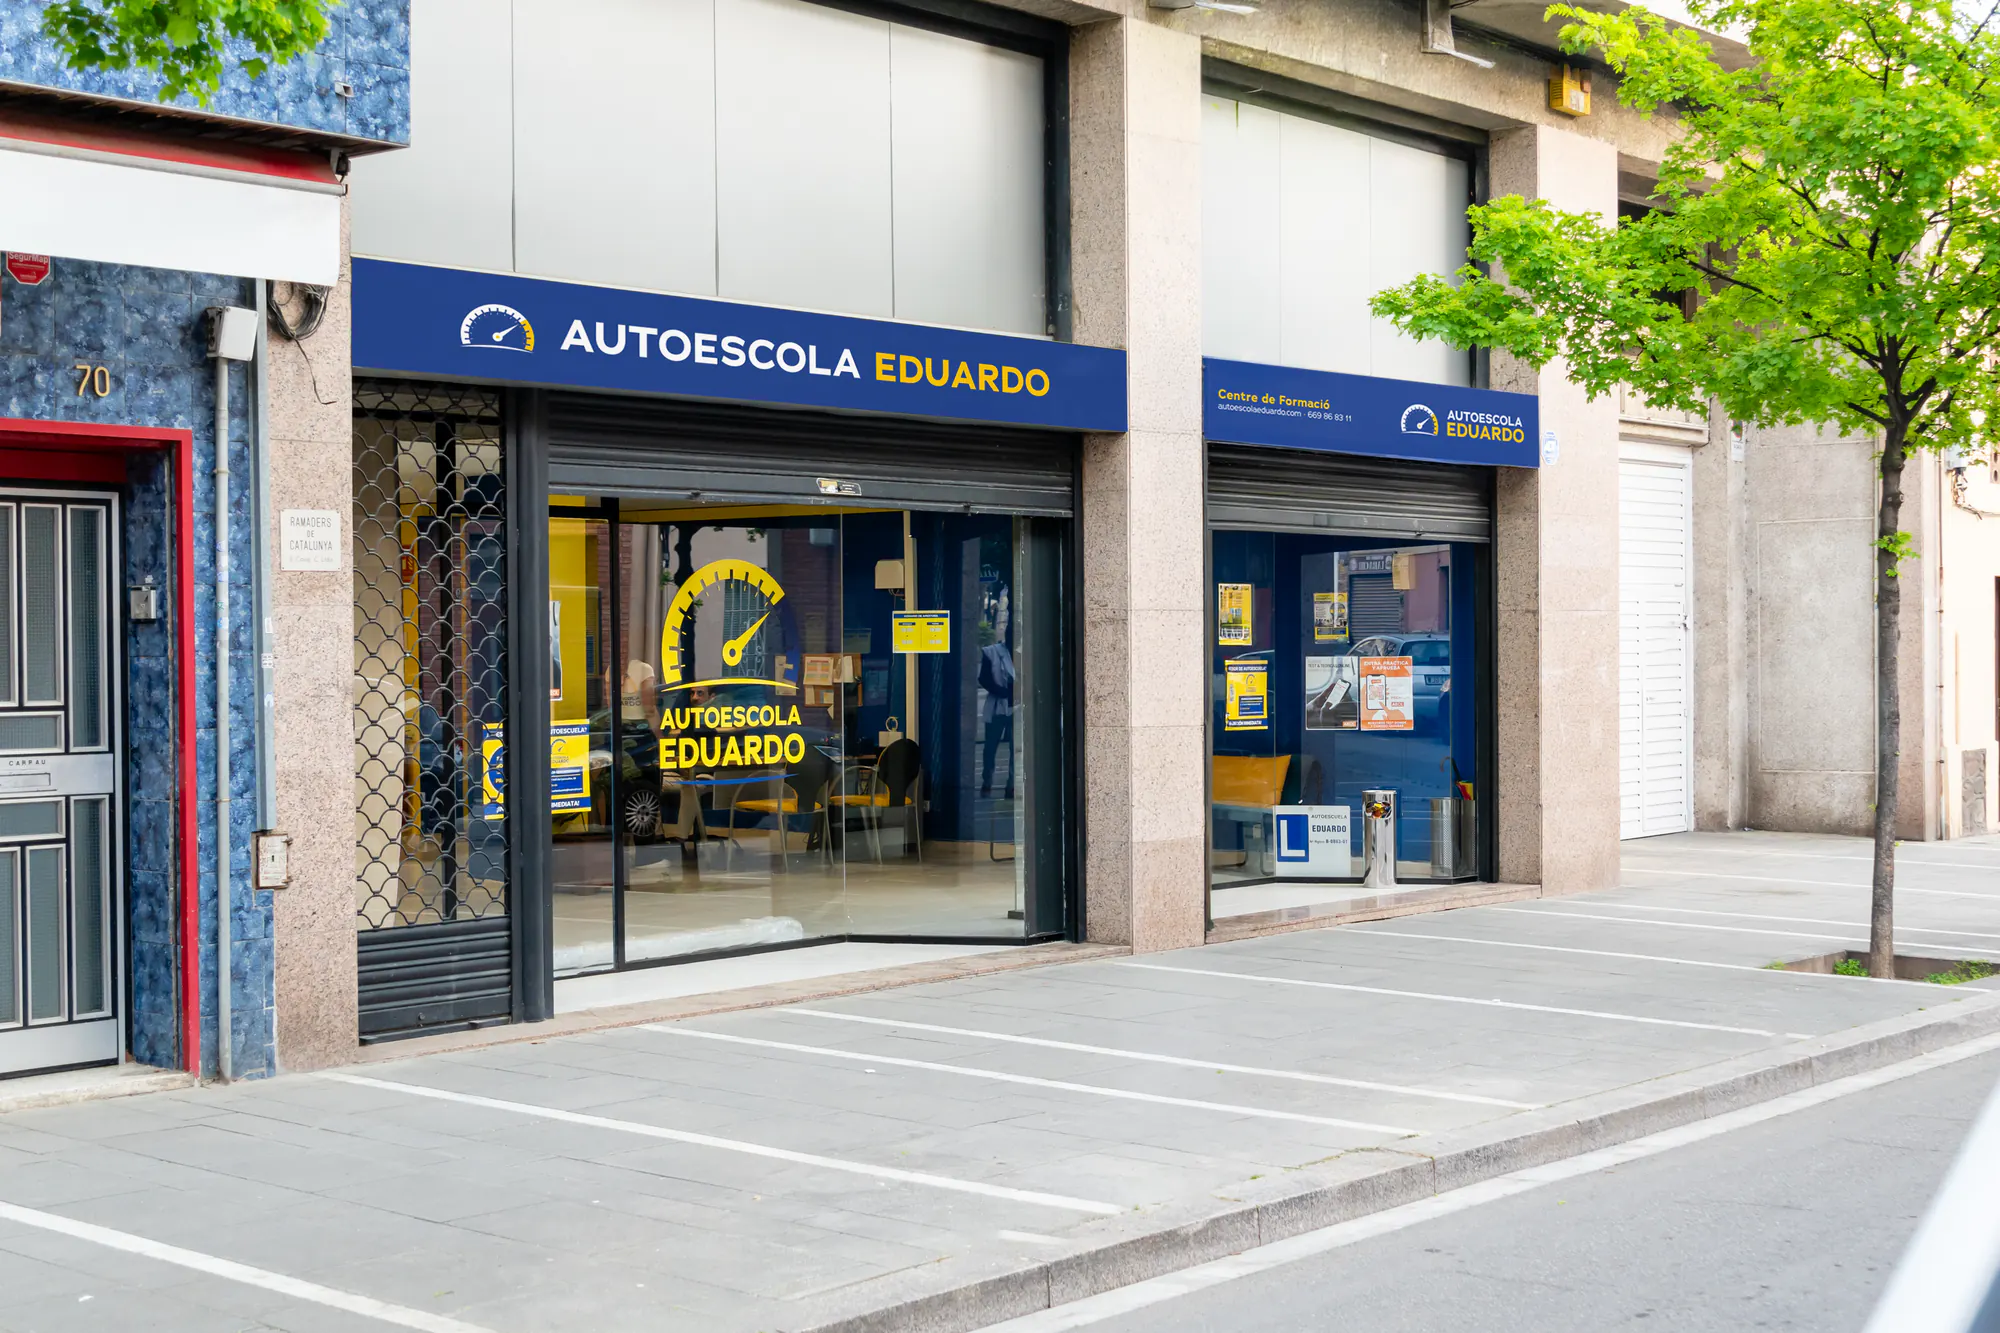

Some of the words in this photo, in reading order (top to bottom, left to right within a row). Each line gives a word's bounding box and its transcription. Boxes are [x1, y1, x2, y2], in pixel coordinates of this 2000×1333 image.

[9, 252, 49, 264] SegurMap
[561, 319, 861, 379] AUTOESCOLA
[875, 352, 1050, 397] EDUARDO
[76, 363, 110, 397] 70
[1218, 388, 1258, 403] Centre
[1261, 393, 1276, 405] de
[1279, 395, 1331, 410] Formació
[1217, 403, 1302, 417] autoescolaeduardo.com
[1307, 410, 1322, 420] 669
[1323, 412, 1333, 421] 86
[1334, 413, 1344, 422] 83
[1345, 414, 1352, 422] 11
[1447, 409, 1523, 427] AUTOESCOLA
[1446, 422, 1525, 444] EDUARDO
[290, 516, 332, 528] RAMADERS
[306, 529, 315, 538] DE
[289, 539, 333, 551] CATALUNYA
[660, 704, 801, 731] AUTOESCOLA
[659, 733, 805, 770] EDUARDO
[1280, 819, 1305, 857] L
